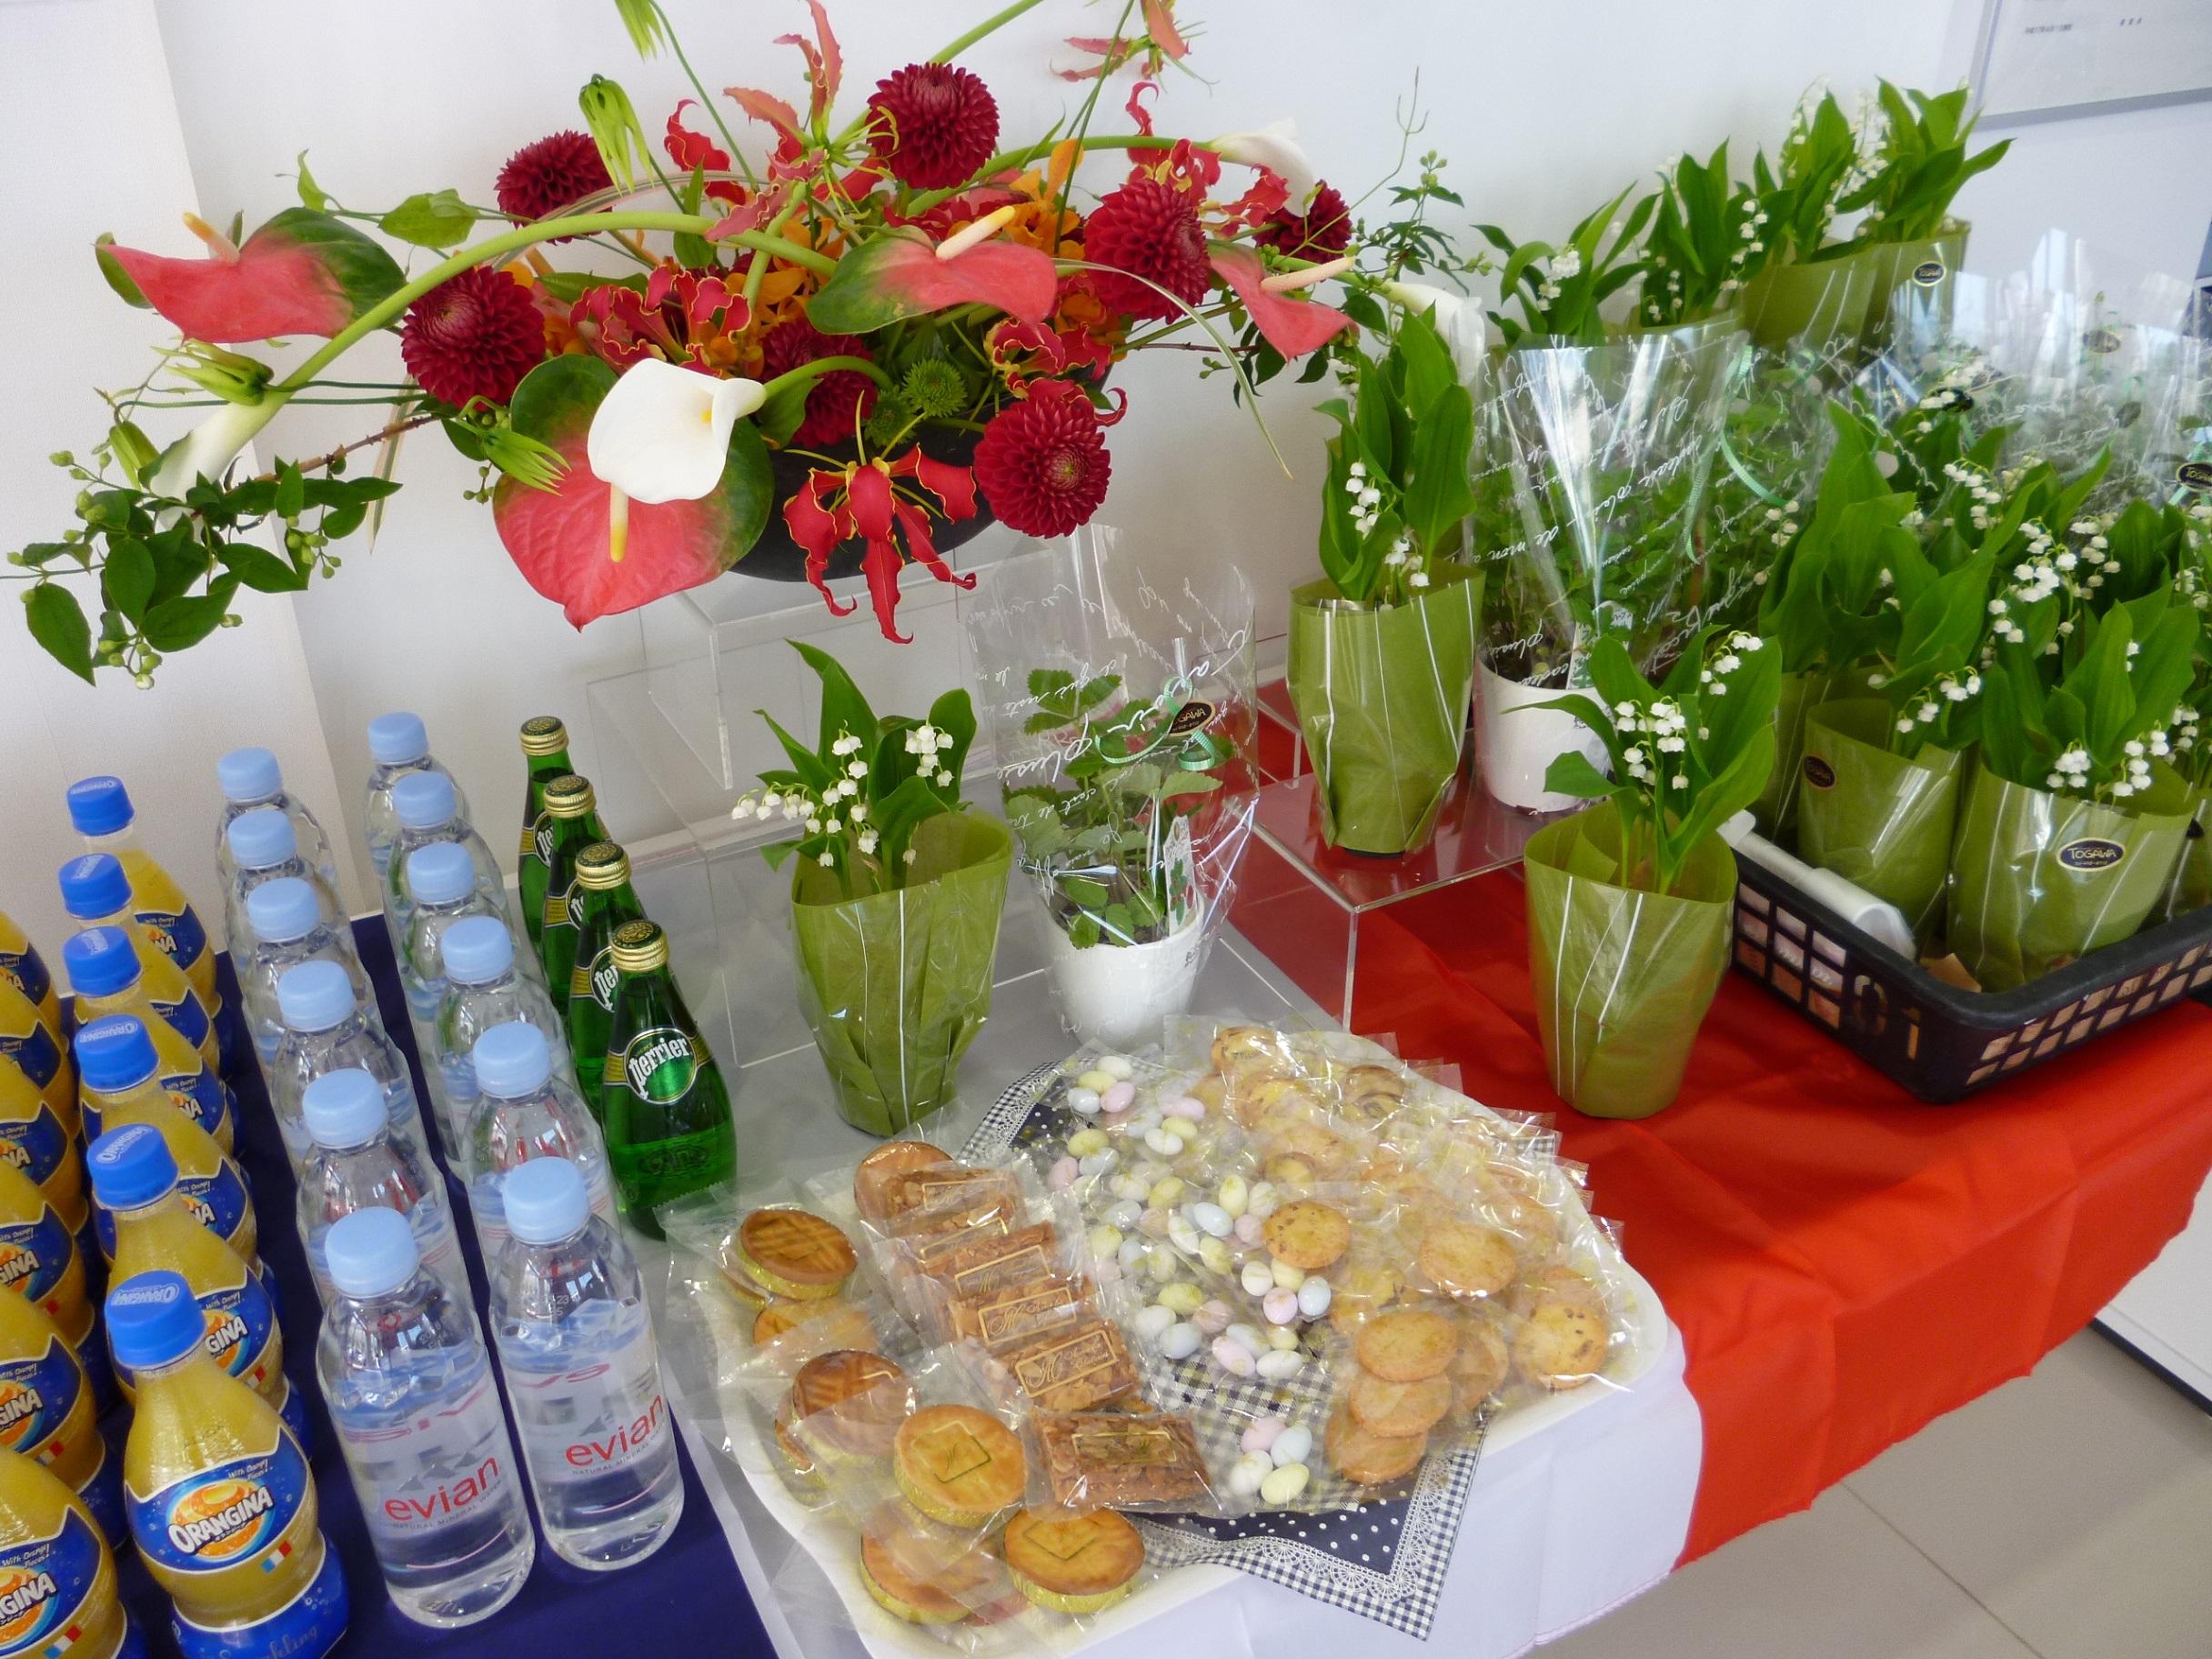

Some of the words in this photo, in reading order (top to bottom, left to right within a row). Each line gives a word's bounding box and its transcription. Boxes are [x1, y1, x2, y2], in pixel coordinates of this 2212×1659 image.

[2067, 847, 2116, 860] TOGAWA
[566, 1395, 664, 1467] evian
[168, 1486, 274, 1553] ORANGINA
[385, 1457, 499, 1522] evian
